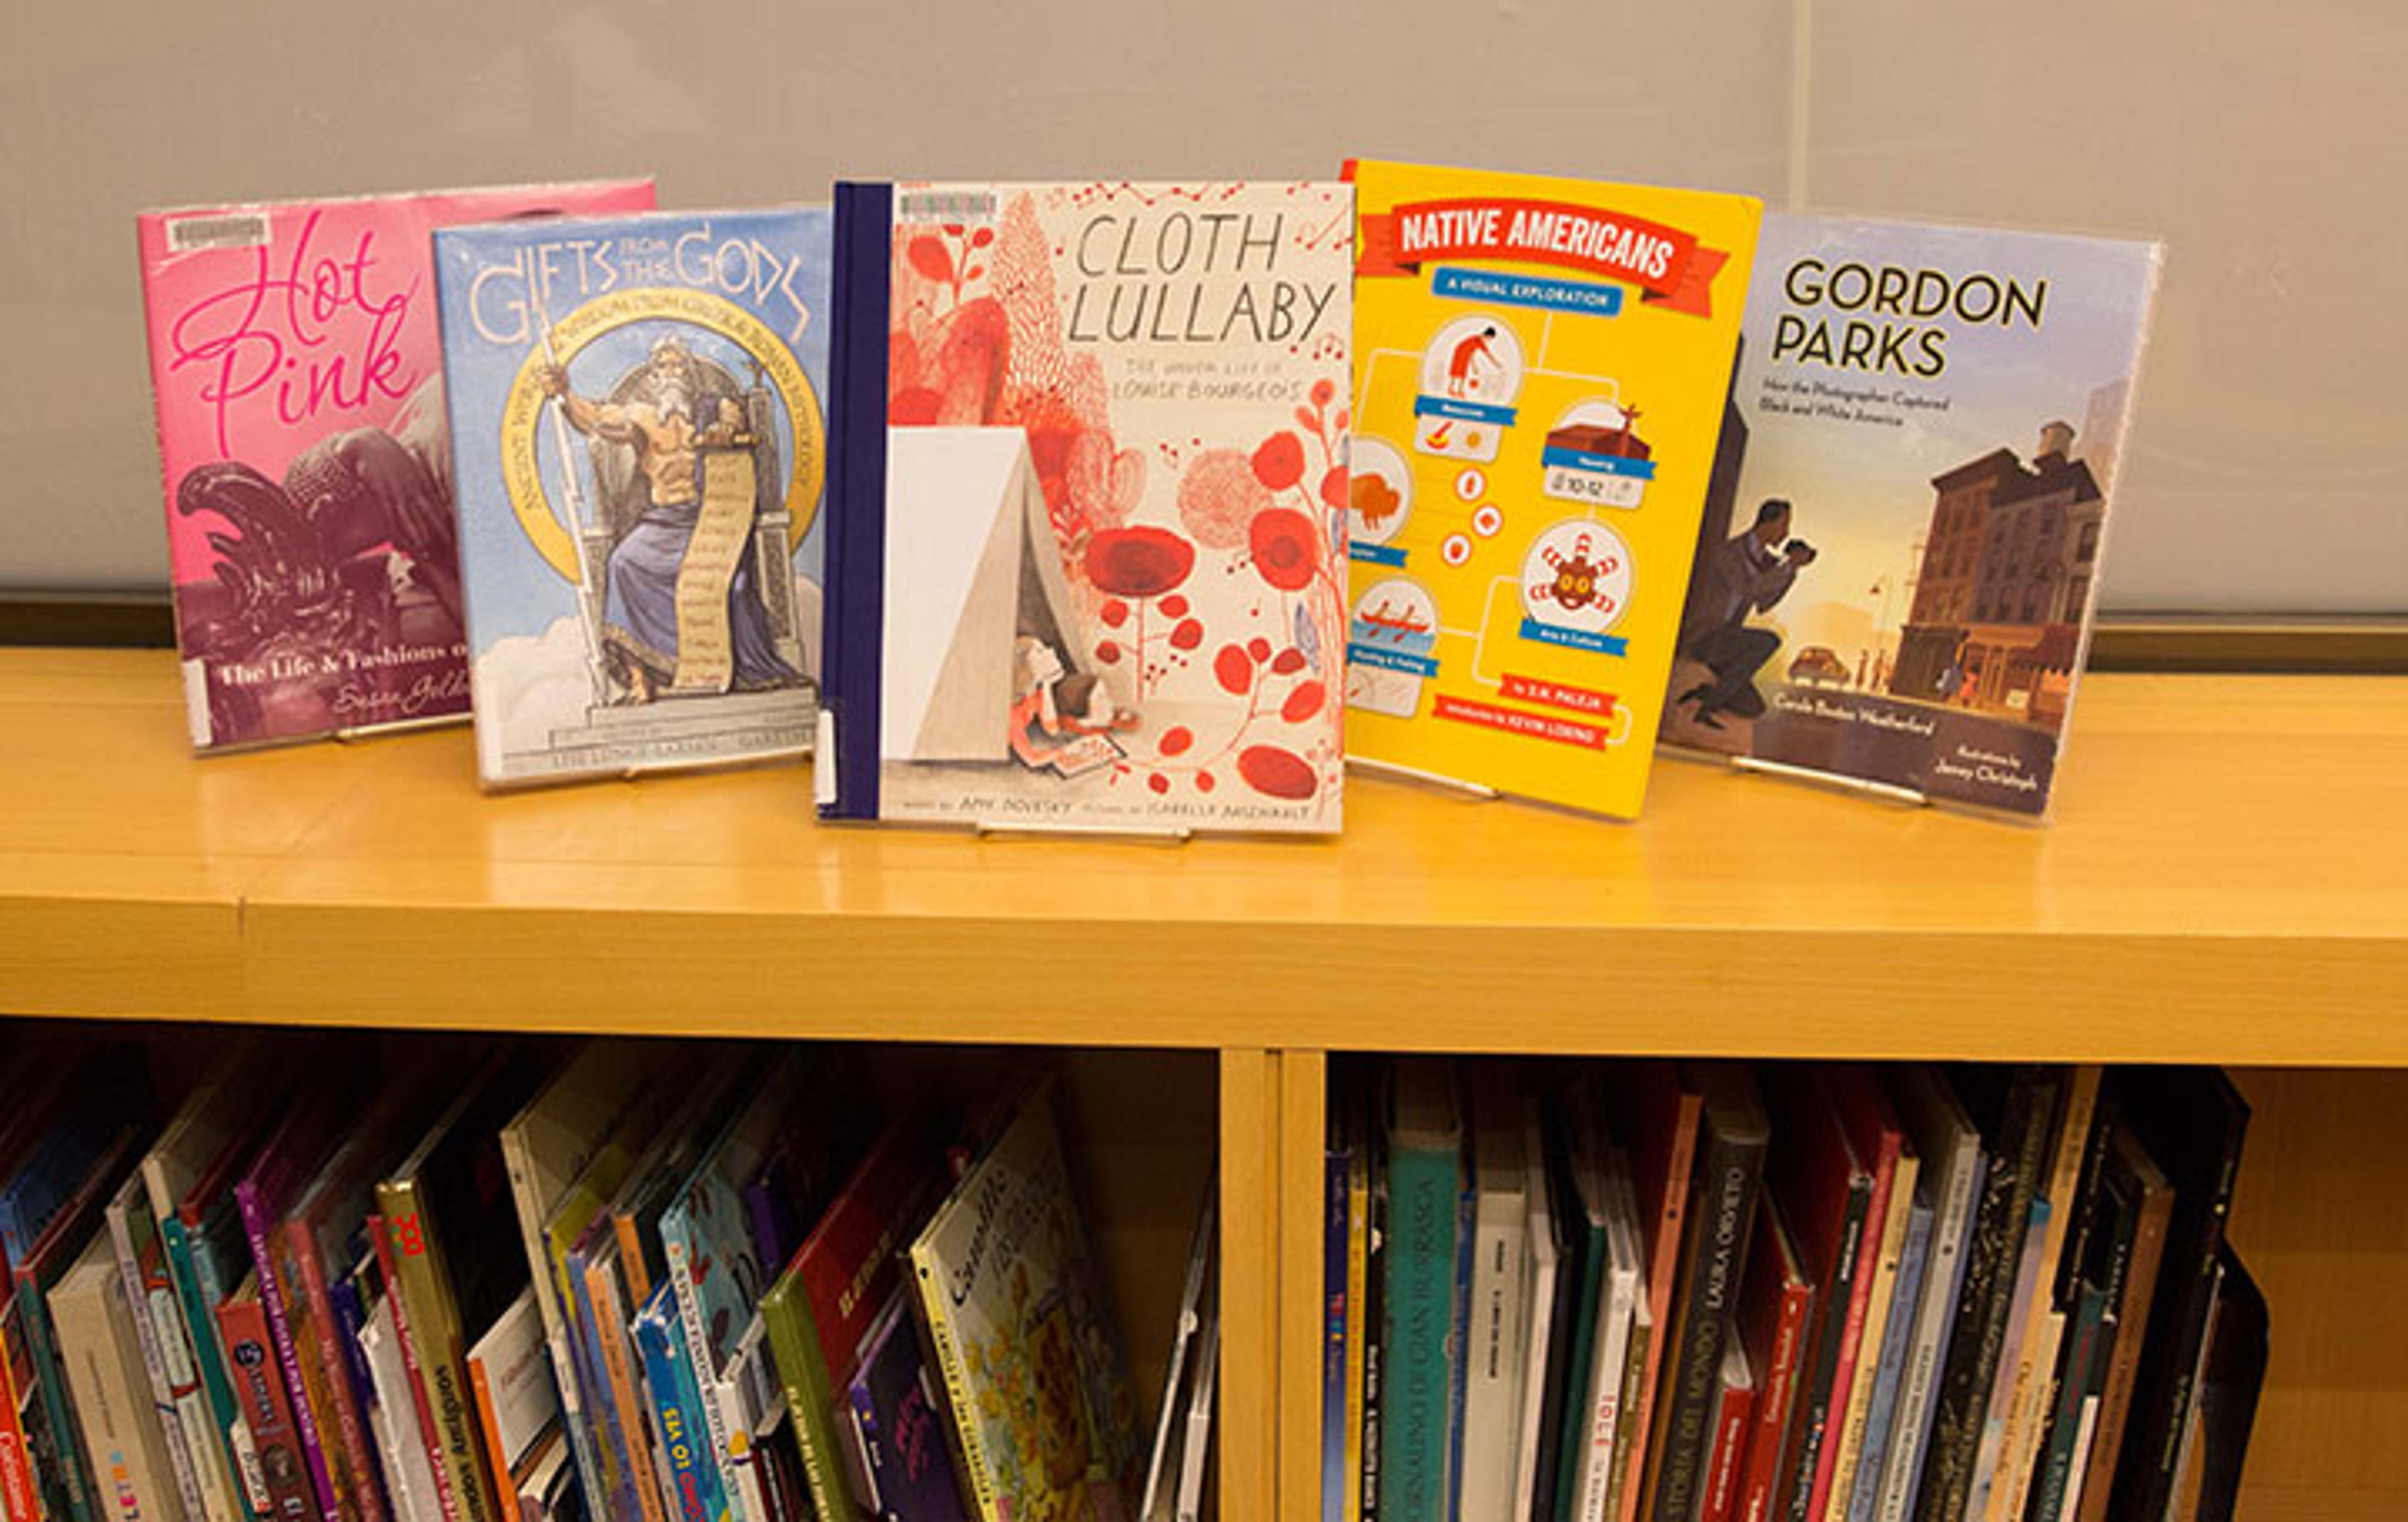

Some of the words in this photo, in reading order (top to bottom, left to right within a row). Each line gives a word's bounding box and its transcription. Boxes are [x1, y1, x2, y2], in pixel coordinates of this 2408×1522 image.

[1077, 213, 1283, 276] CLOTH
[1402, 209, 1502, 252] NATIVE
[1508, 210, 1675, 278] AMERICANS
[172, 210, 385, 357] Hot
[470, 242, 619, 344] GIFTS
[621, 259, 671, 280] THE
[675, 221, 810, 344] GODS
[1069, 281, 1337, 342] LULLABY
[1449, 278, 1458, 290] A
[1460, 279, 1507, 297] VISUAL
[1512, 285, 1609, 307] EXPLORATION
[1785, 260, 2047, 327] GORDON
[169, 282, 419, 459] Pink
[1772, 315, 1947, 377] PARKS
[1112, 379, 1176, 399] LOUISE
[1760, 397, 1789, 411] Black
[1792, 402, 1812, 415] and
[1817, 403, 1850, 420] White
[1855, 408, 1904, 426] America
[1792, 381, 1809, 394] the
[1813, 381, 1888, 402] Photographer
[1893, 390, 1950, 411] Captured
[219, 663, 266, 687] The
[272, 657, 315, 684] Life
[321, 654, 340, 675] &
[345, 645, 445, 671] Fashions
[1702, 1245, 1729, 1309] LAURA
[1685, 1319, 1716, 1400] MONDO
[662, 1408, 684, 1440] VES
